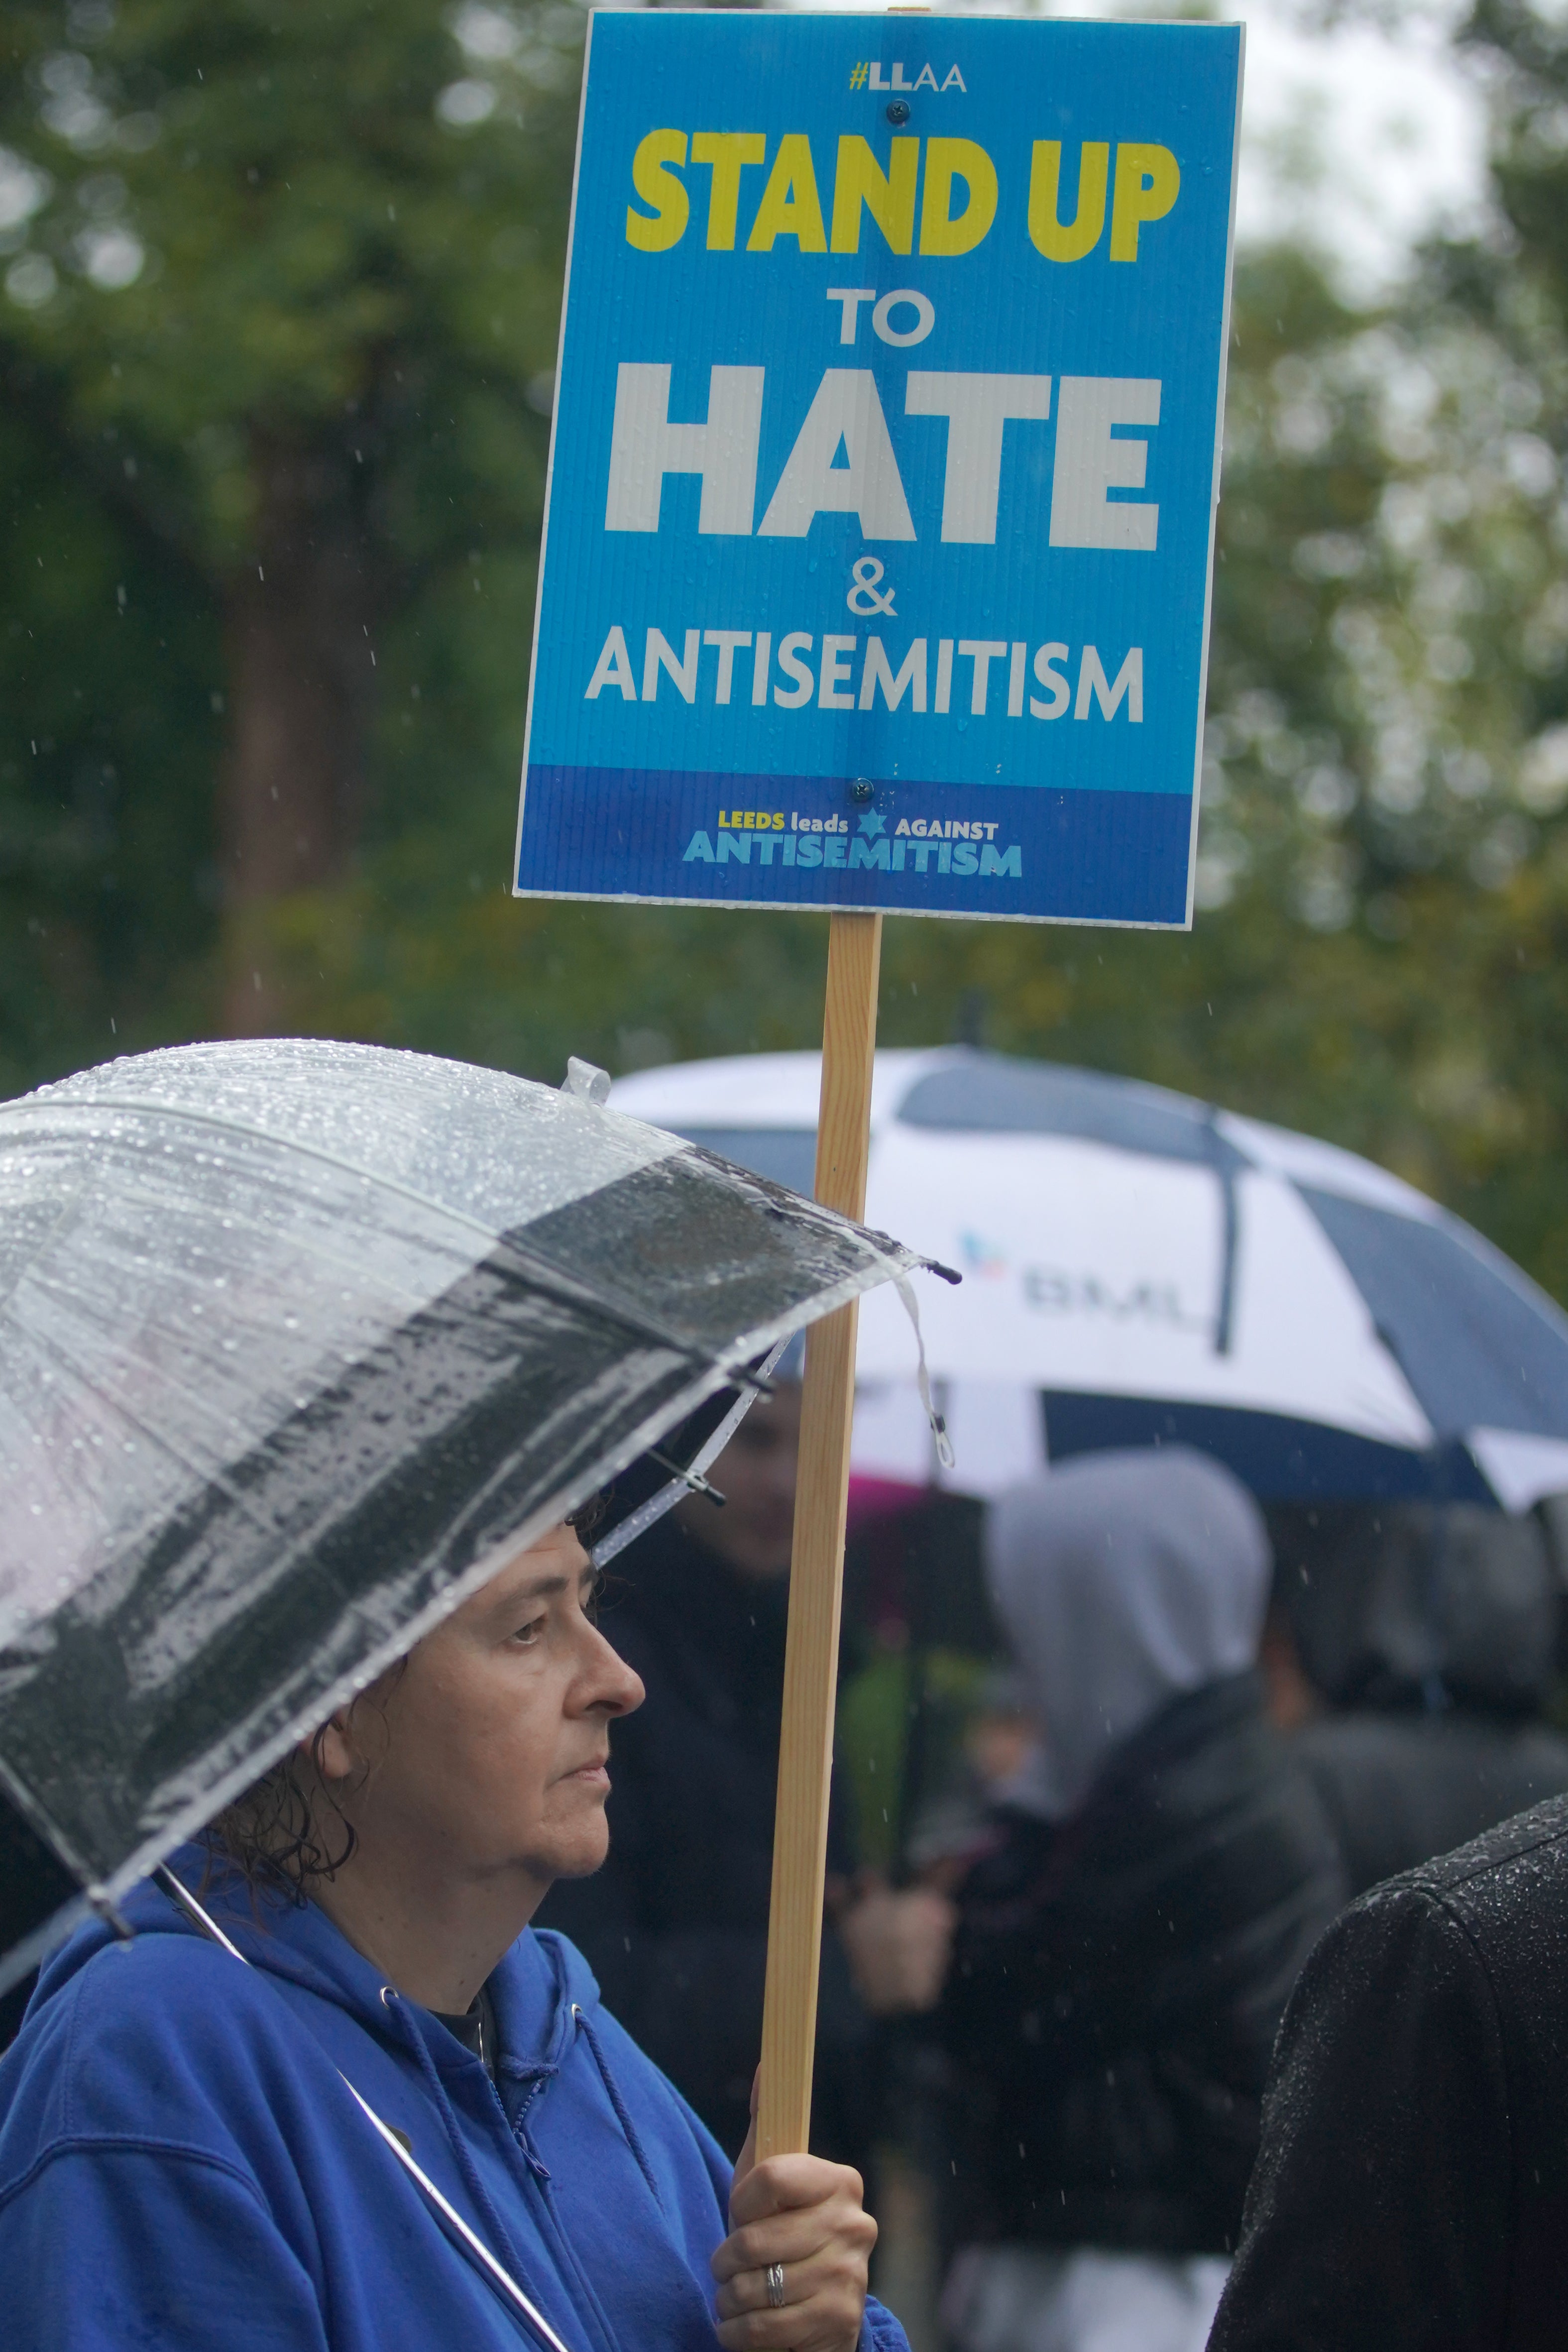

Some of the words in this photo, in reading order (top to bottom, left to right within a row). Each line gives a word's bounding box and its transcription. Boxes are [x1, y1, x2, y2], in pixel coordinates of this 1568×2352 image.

[849, 61, 967, 93] #LLAA
[625, 128, 999, 256] STAND
[1027, 139, 1181, 263] UP
[826, 288, 935, 347] TO
[604, 362, 1162, 552] HATE
[846, 556, 898, 616] &
[584, 625, 1143, 723] ANTISEMITISM
[682, 830, 1022, 878] ANTISEMITISM
[718, 810, 785, 830] LEEDS
[791, 811, 848, 833] leads
[895, 818, 999, 840] AGAINST
